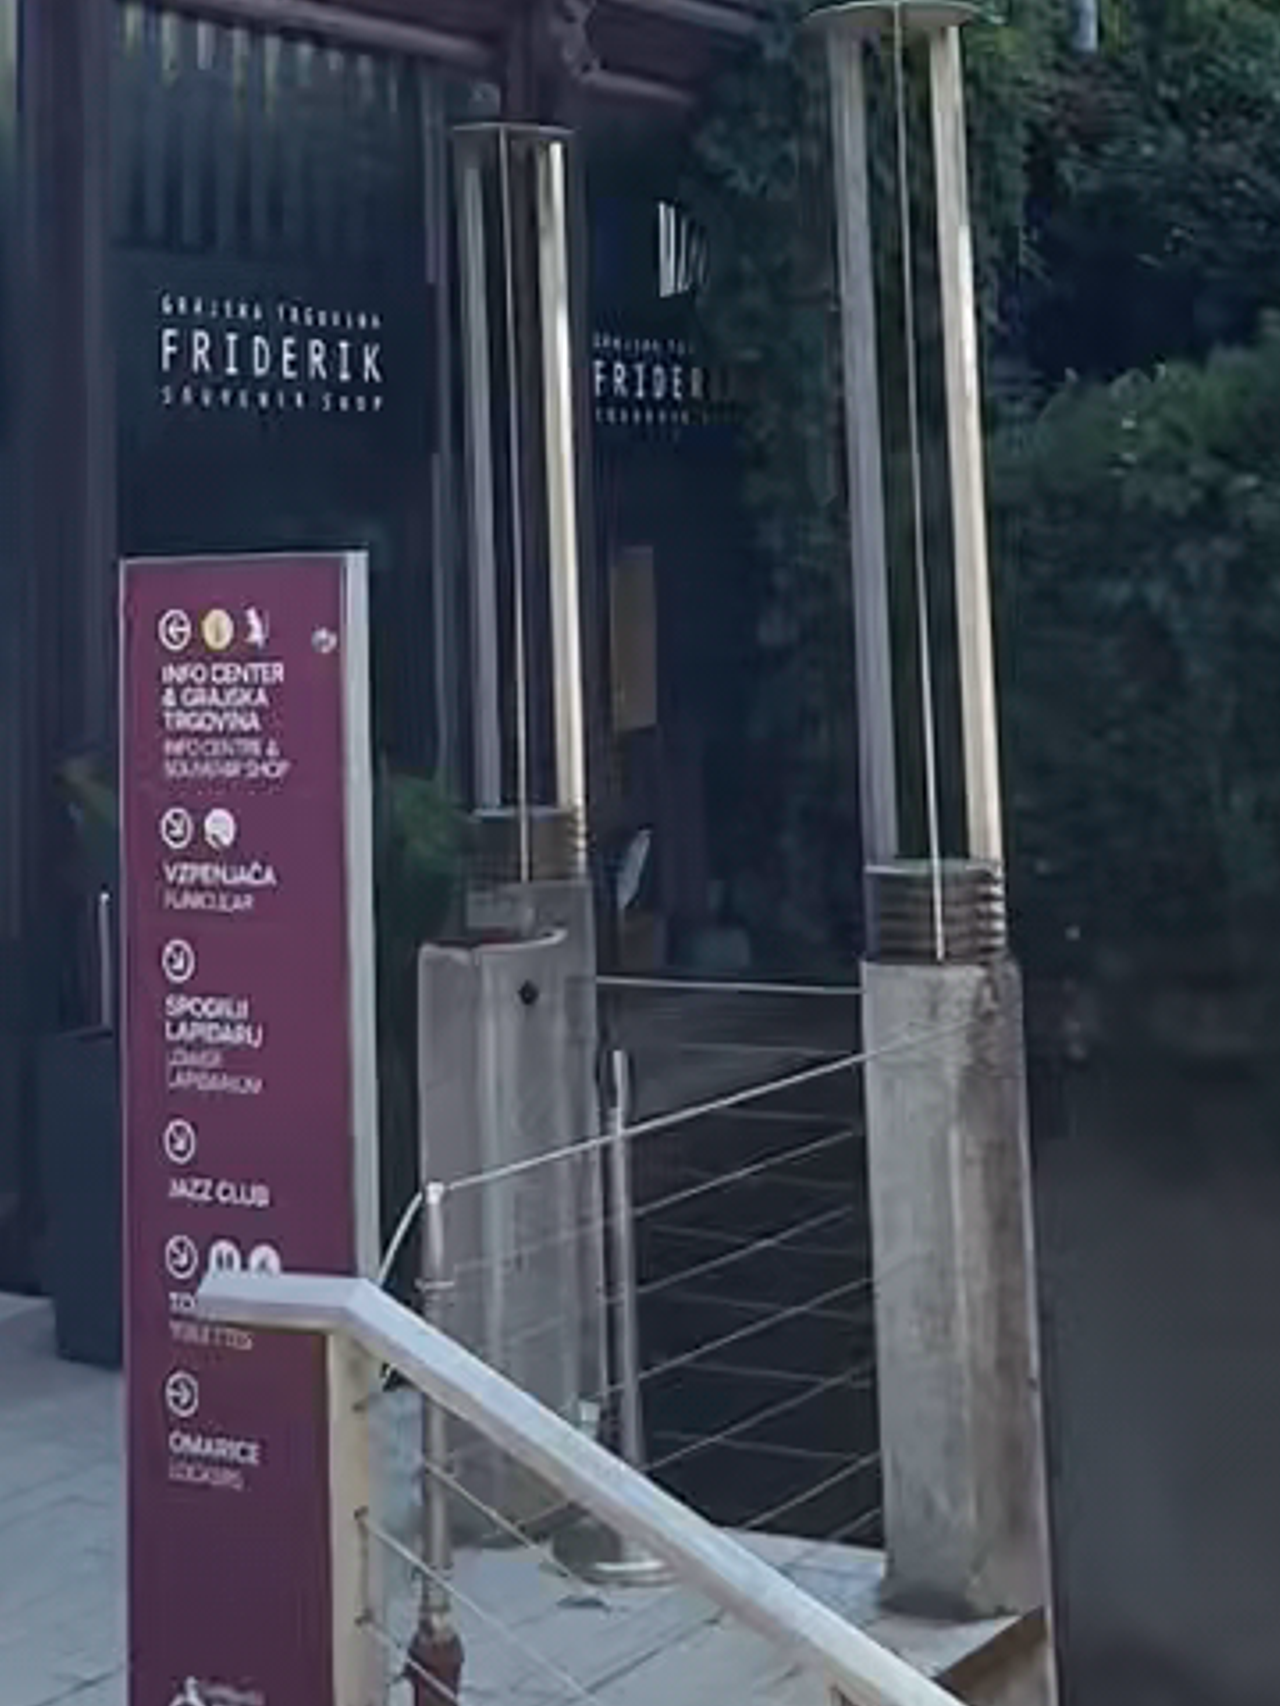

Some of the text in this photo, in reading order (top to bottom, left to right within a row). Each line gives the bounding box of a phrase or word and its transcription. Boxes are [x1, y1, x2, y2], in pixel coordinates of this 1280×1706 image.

[161, 328, 383, 383] FRIDERIK
[162, 661, 285, 685] INFO CENTER
[162, 687, 270, 708] & GRAJSKA
[163, 710, 262, 732] TRGOVINA
[168, 1177, 270, 1208] JAZZ CLUB
